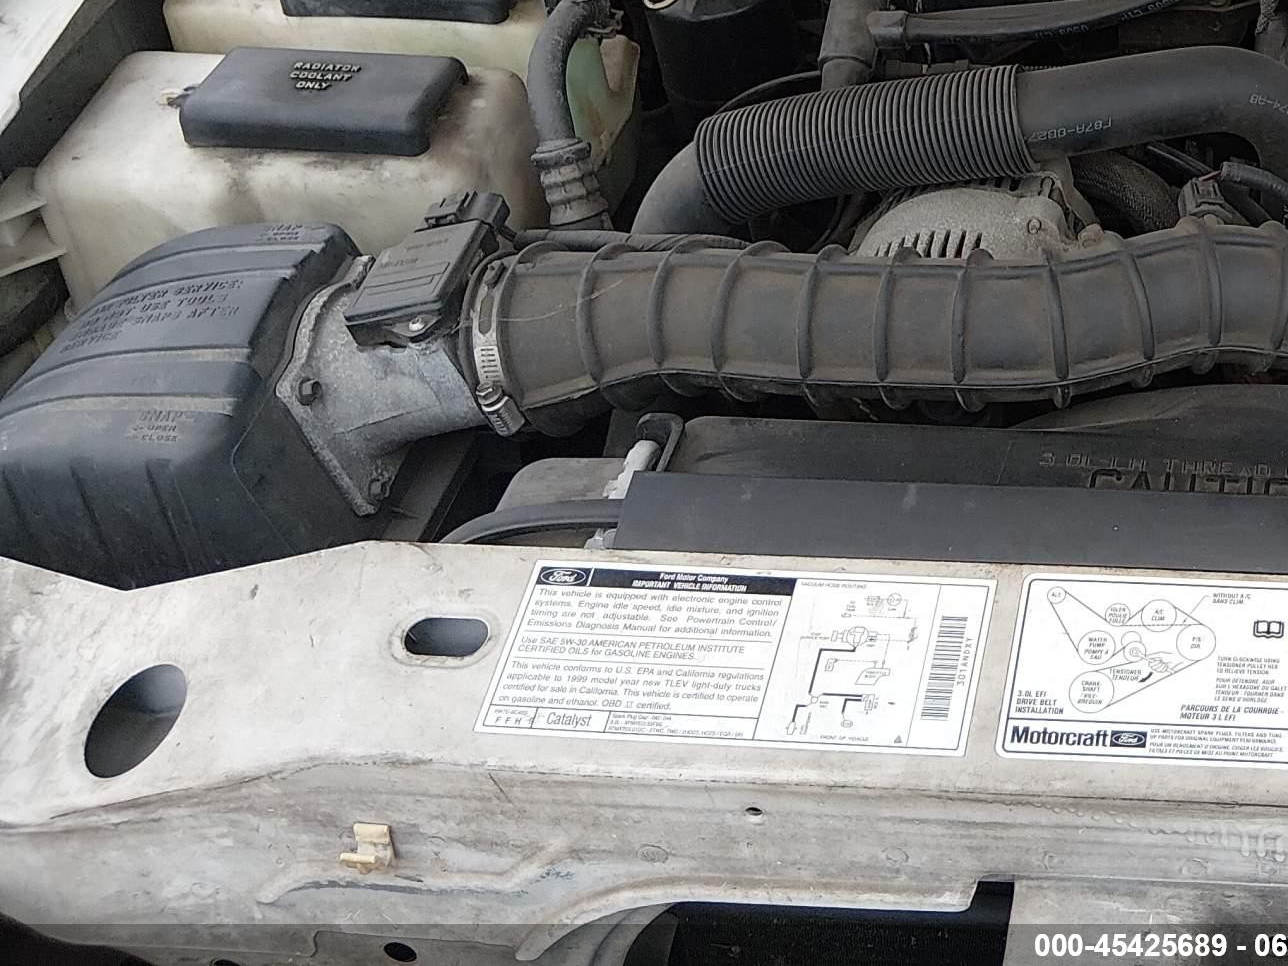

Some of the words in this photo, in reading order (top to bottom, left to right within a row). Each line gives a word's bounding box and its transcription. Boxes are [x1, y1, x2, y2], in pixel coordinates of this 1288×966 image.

[290, 70, 352, 81] COOLANT
[295, 80, 332, 90] ONLY
[549, 569, 577, 582] Ford
[659, 572, 676, 580] Ford
[697, 574, 728, 582] Company
[632, 580, 670, 588] IMPORTANT
[673, 582, 700, 590] VEHICLE
[701, 583, 747, 592] INFORMATION
[539, 588, 557, 596] This
[606, 592, 647, 600] equipped
[672, 594, 714, 603] electronic
[527, 618, 572, 627] Emissions
[575, 621, 619, 630] Diagnosis
[622, 623, 656, 631] Manual
[674, 626, 718, 634] additional
[518, 644, 566, 653] CERTIFIED
[568, 646, 589, 655] OILS
[604, 648, 651, 658] GASOLINE
[540, 636, 558, 644] SAE
[560, 638, 587, 646] 5W-30
[588, 639, 637, 648] AMERICAN
[638, 641, 695, 651] PETROLEUM
[697, 644, 744, 653] INSTITUTE
[512, 660, 528, 669] This
[531, 662, 560, 670] vehicle
[615, 666, 633, 674] U.S.
[636, 667, 654, 675] EPA
[675, 669, 715, 678] California
[718, 672, 764, 680] regulations
[1015, 706, 1063, 714] INSTALLATION
[1180, 704, 1218, 712] PARCOURS
[546, 711, 592, 727] Catalyst
[1180, 712, 1209, 720] MOTEUR
[1010, 725, 1108, 747] Motorcraft
[1118, 732, 1139, 745] Ford
